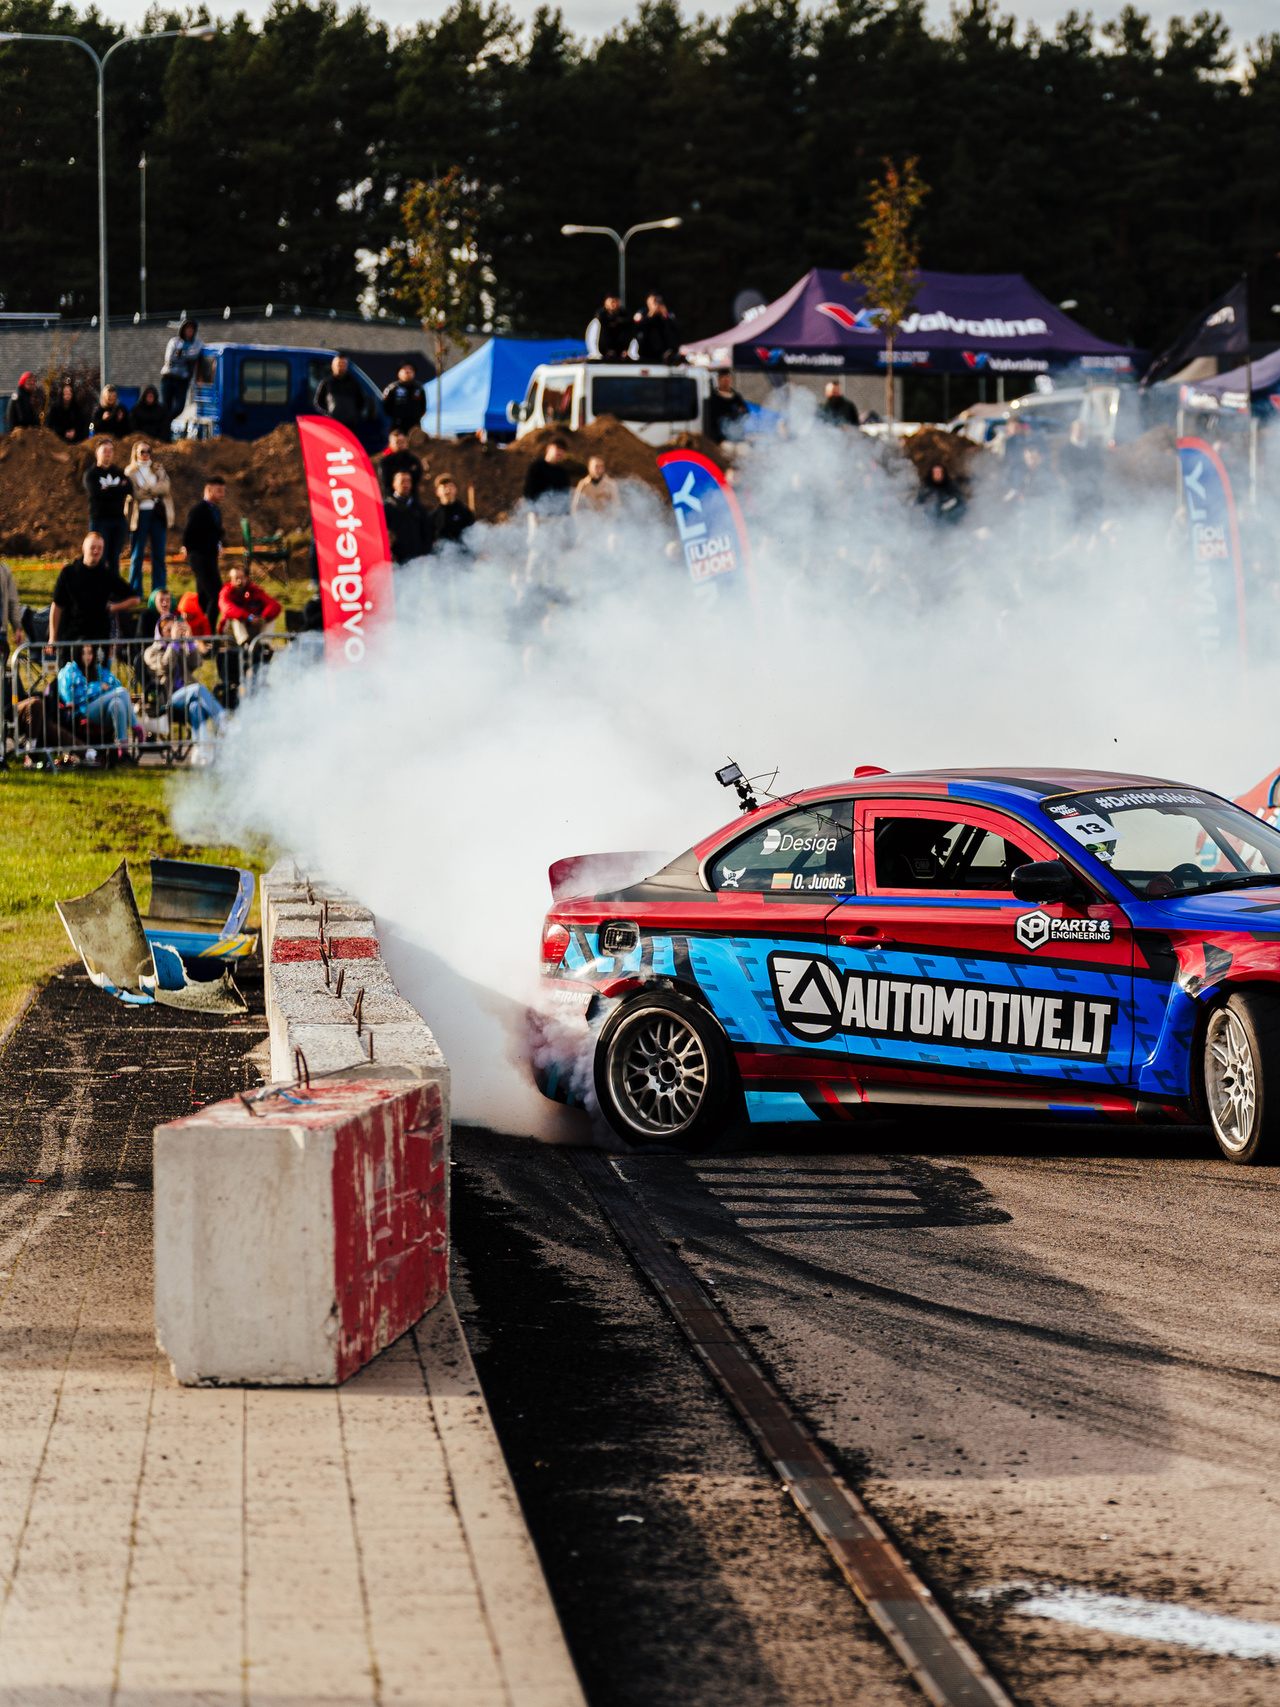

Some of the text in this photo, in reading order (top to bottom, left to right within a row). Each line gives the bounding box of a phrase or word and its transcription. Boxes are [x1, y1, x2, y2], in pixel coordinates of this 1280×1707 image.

[900, 311, 1048, 338] Valvoline
[1076, 822, 1106, 835] 13
[779, 834, 838, 855] Desiga
[793, 873, 847, 890] O. Juodis
[1051, 919, 1111, 933] PARTS &
[1051, 931, 1111, 941] ENGINEERING
[841, 976, 1111, 1055] AUTOMOTIVE.LT
